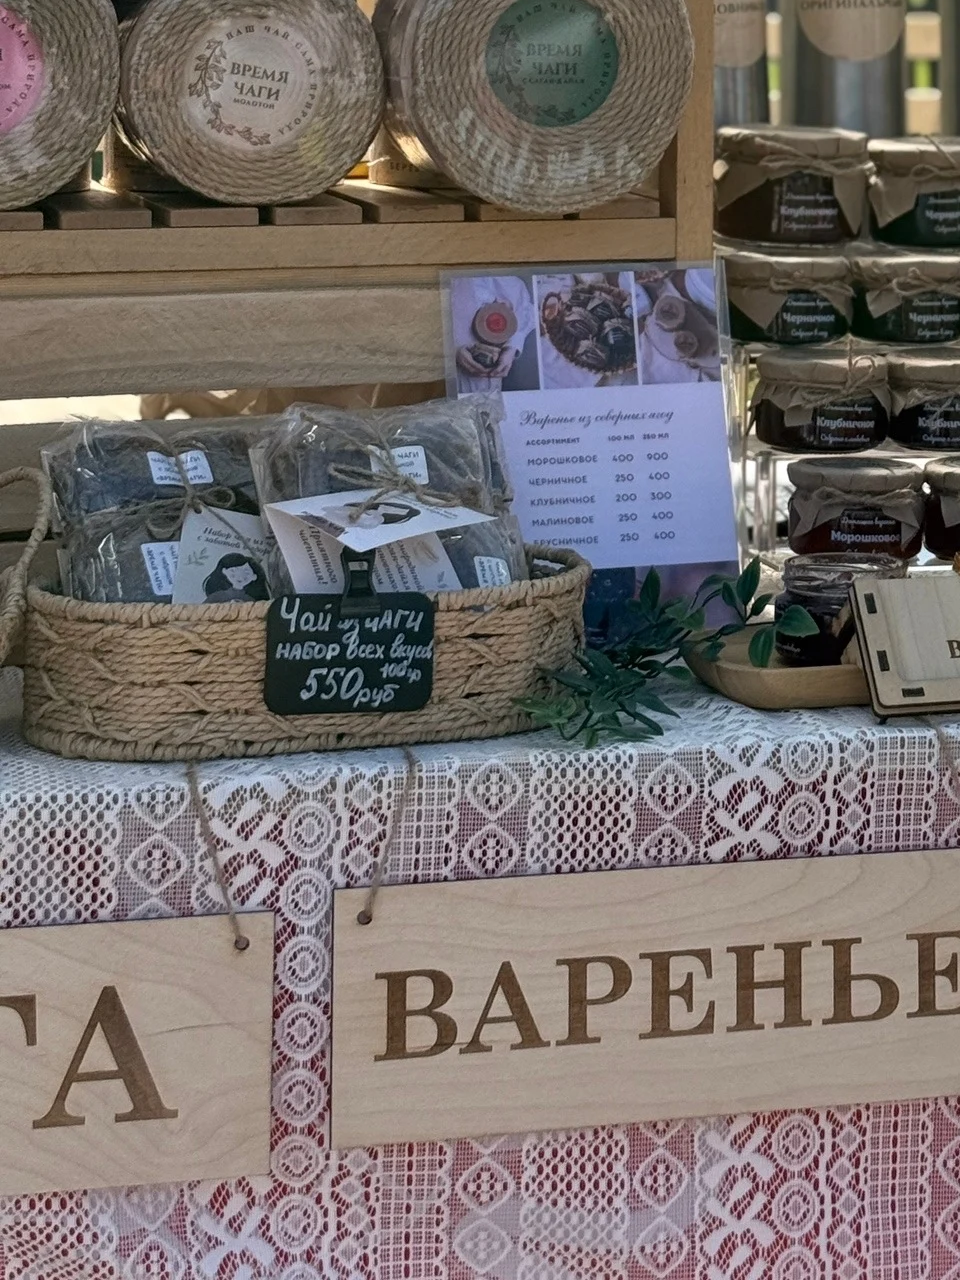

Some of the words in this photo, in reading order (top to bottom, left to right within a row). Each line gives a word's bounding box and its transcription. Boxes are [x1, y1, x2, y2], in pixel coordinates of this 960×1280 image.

[526, 43, 583, 57] ВРЕМЯ
[230, 61, 290, 84] ВРЕМЯ
[532, 61, 578, 75] ЧАГИ
[234, 81, 281, 101] ЧАГИ
[520, 410, 577, 430] Варенье
[578, 415, 592, 428] из
[525, 437, 581, 446] АССОРТИМЕНТ
[607, 434, 622, 442] 100
[527, 454, 599, 466] МОРОШКОВОЕ
[612, 453, 634, 463] 400
[646, 451, 669, 461] 900
[528, 475, 588, 487] ЧЕРНИЧНОЕ
[615, 473, 635, 483] 250
[648, 471, 670, 481] 400
[530, 495, 596, 507] КЛУБНИЧНОЕ
[615, 493, 637, 503] 200
[650, 491, 672, 501] 300
[532, 515, 595, 527] МАЛИНОВОЕ
[618, 512, 638, 522] 250
[651, 511, 674, 521] 400
[619, 532, 640, 543] 250
[654, 530, 676, 540] 400
[830, 530, 901, 545] Морошковое
[280, 596, 333, 634] Чай
[275, 641, 341, 661] НАБОР
